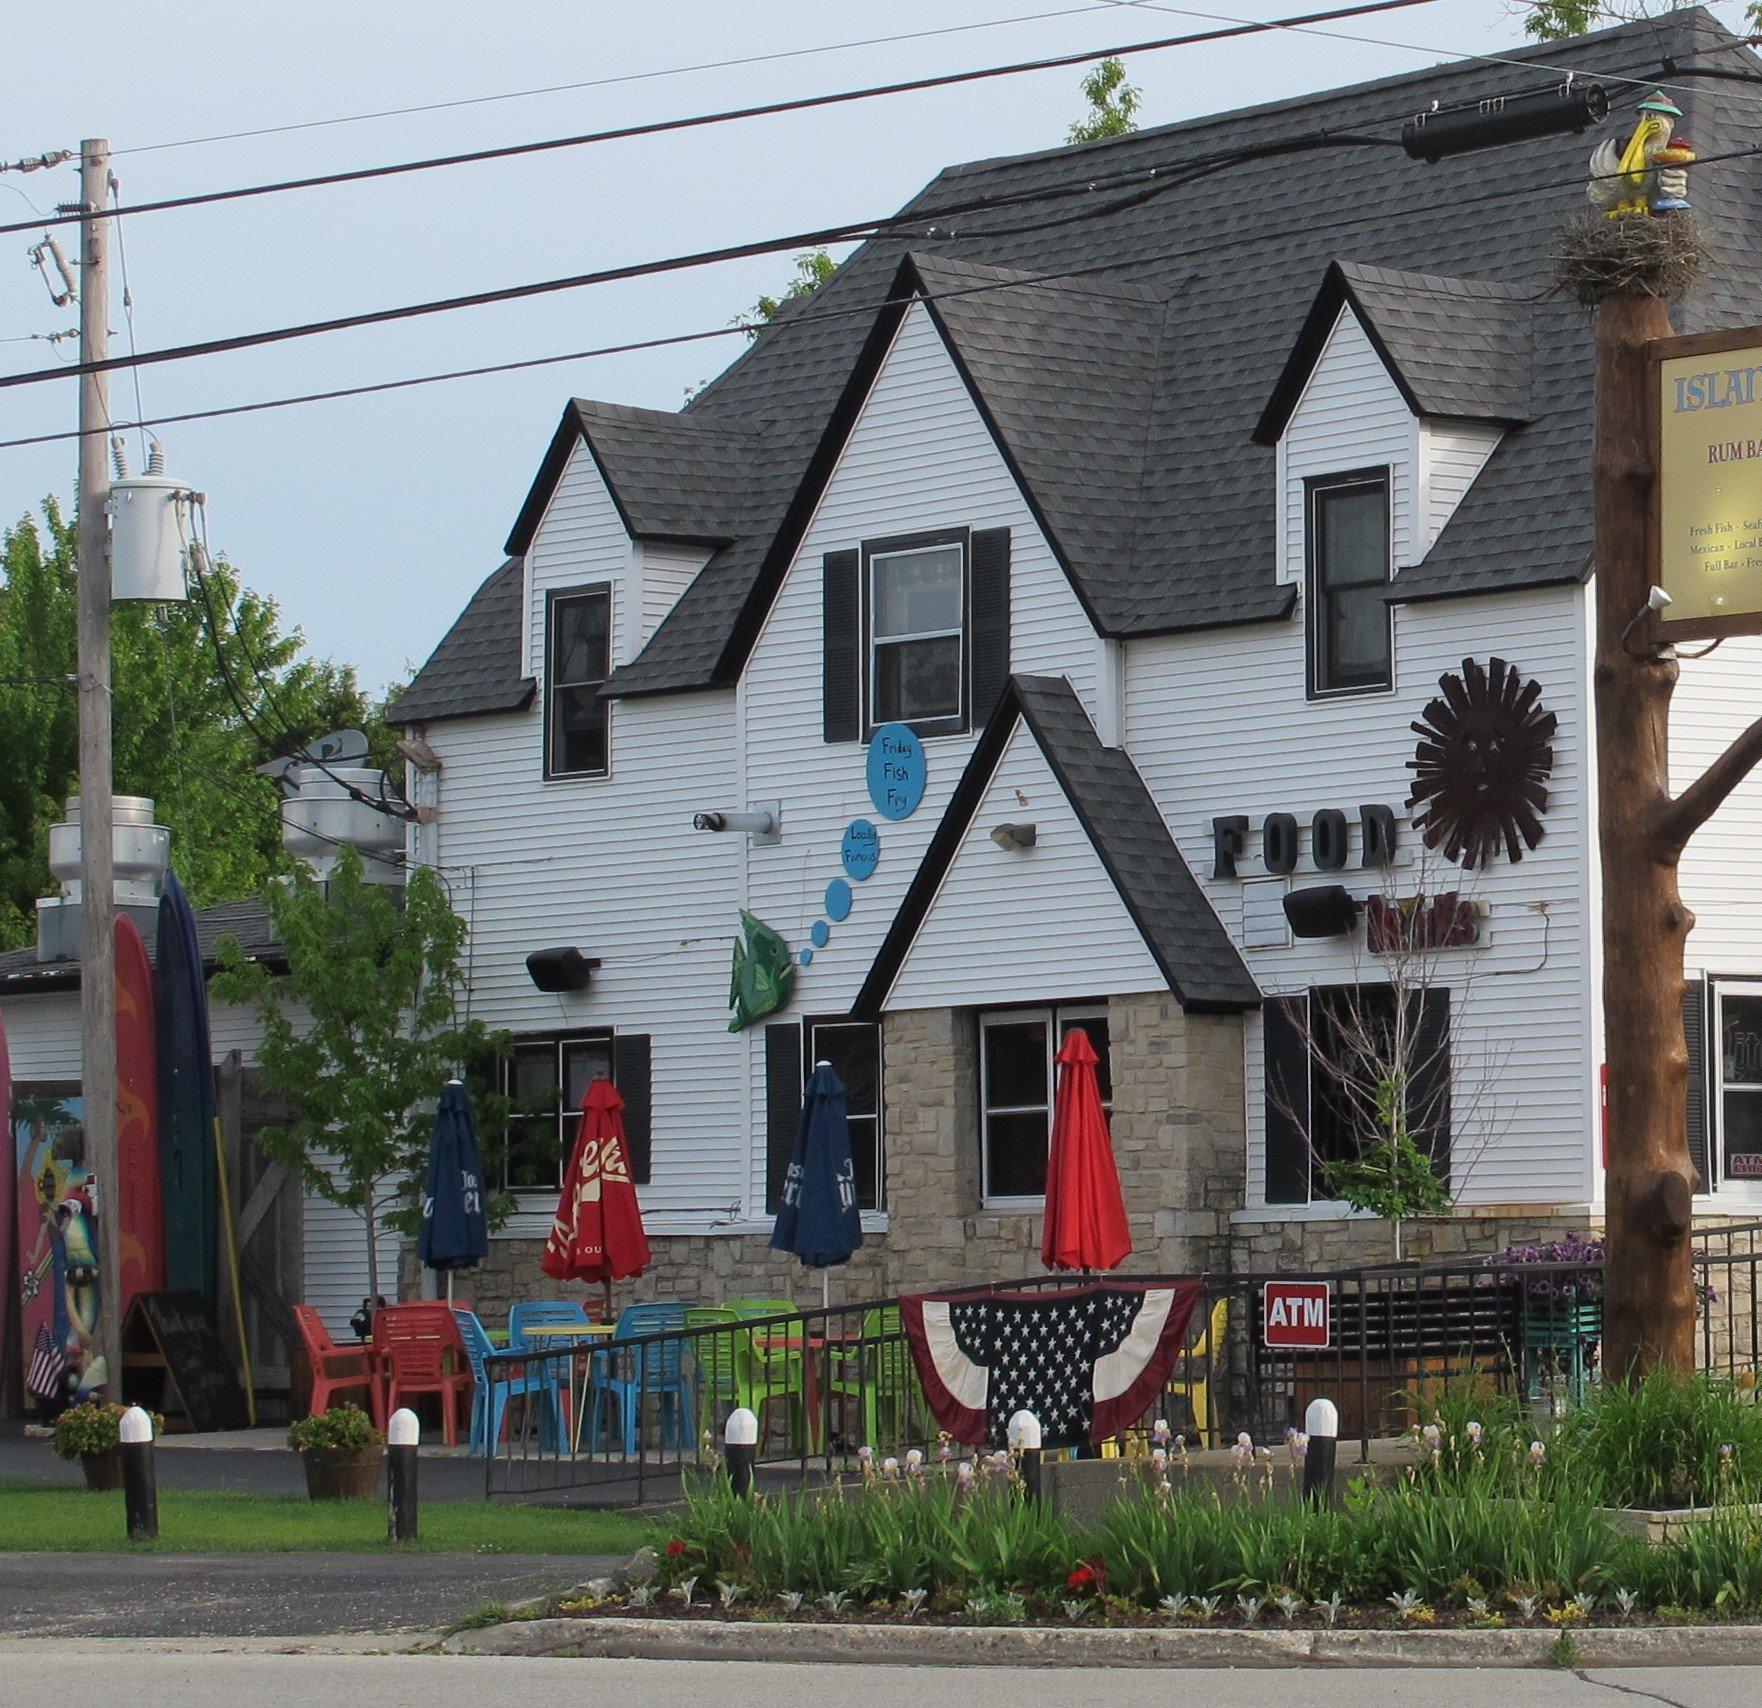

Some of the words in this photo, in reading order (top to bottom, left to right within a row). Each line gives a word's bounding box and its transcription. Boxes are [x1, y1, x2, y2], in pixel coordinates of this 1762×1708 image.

[1708, 442, 1743, 464] RUM
[1690, 525, 1713, 537] Fresh
[1715, 522, 1733, 534] Fish
[1689, 544, 1725, 555] Mexican
[1734, 538, 1757, 550] Local
[1704, 561, 1722, 572] Full
[1723, 559, 1739, 570] Bar
[882, 737, 912, 759] Friday
[884, 762, 908, 781] Fish
[887, 788, 907, 812] Fry
[1212, 804, 1397, 879] FOOD
[1269, 1297, 1324, 1327] ATM
